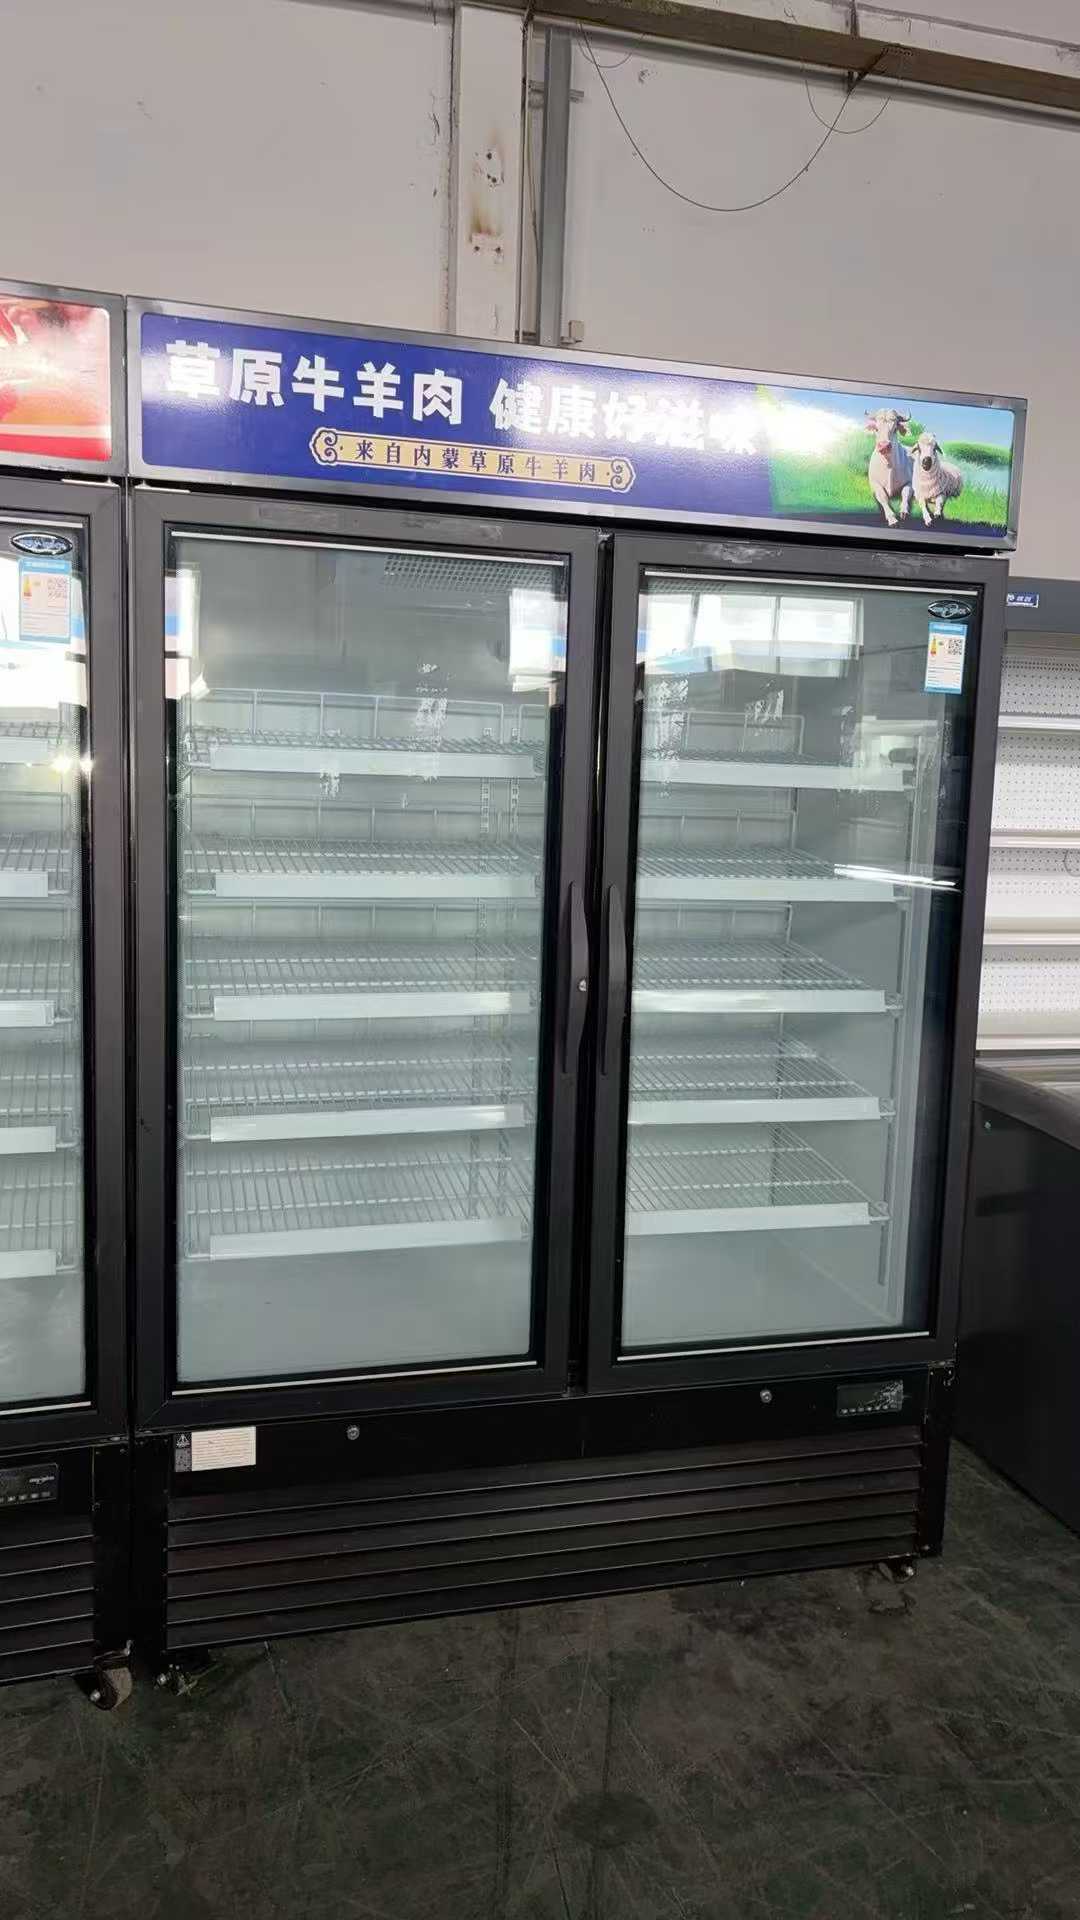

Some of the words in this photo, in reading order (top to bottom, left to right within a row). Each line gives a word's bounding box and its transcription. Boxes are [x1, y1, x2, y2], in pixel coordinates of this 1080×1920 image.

[165, 340, 463, 425] 草原牛羊肉
[354, 439, 597, 483] 来自内蒙草原牛羊肉
